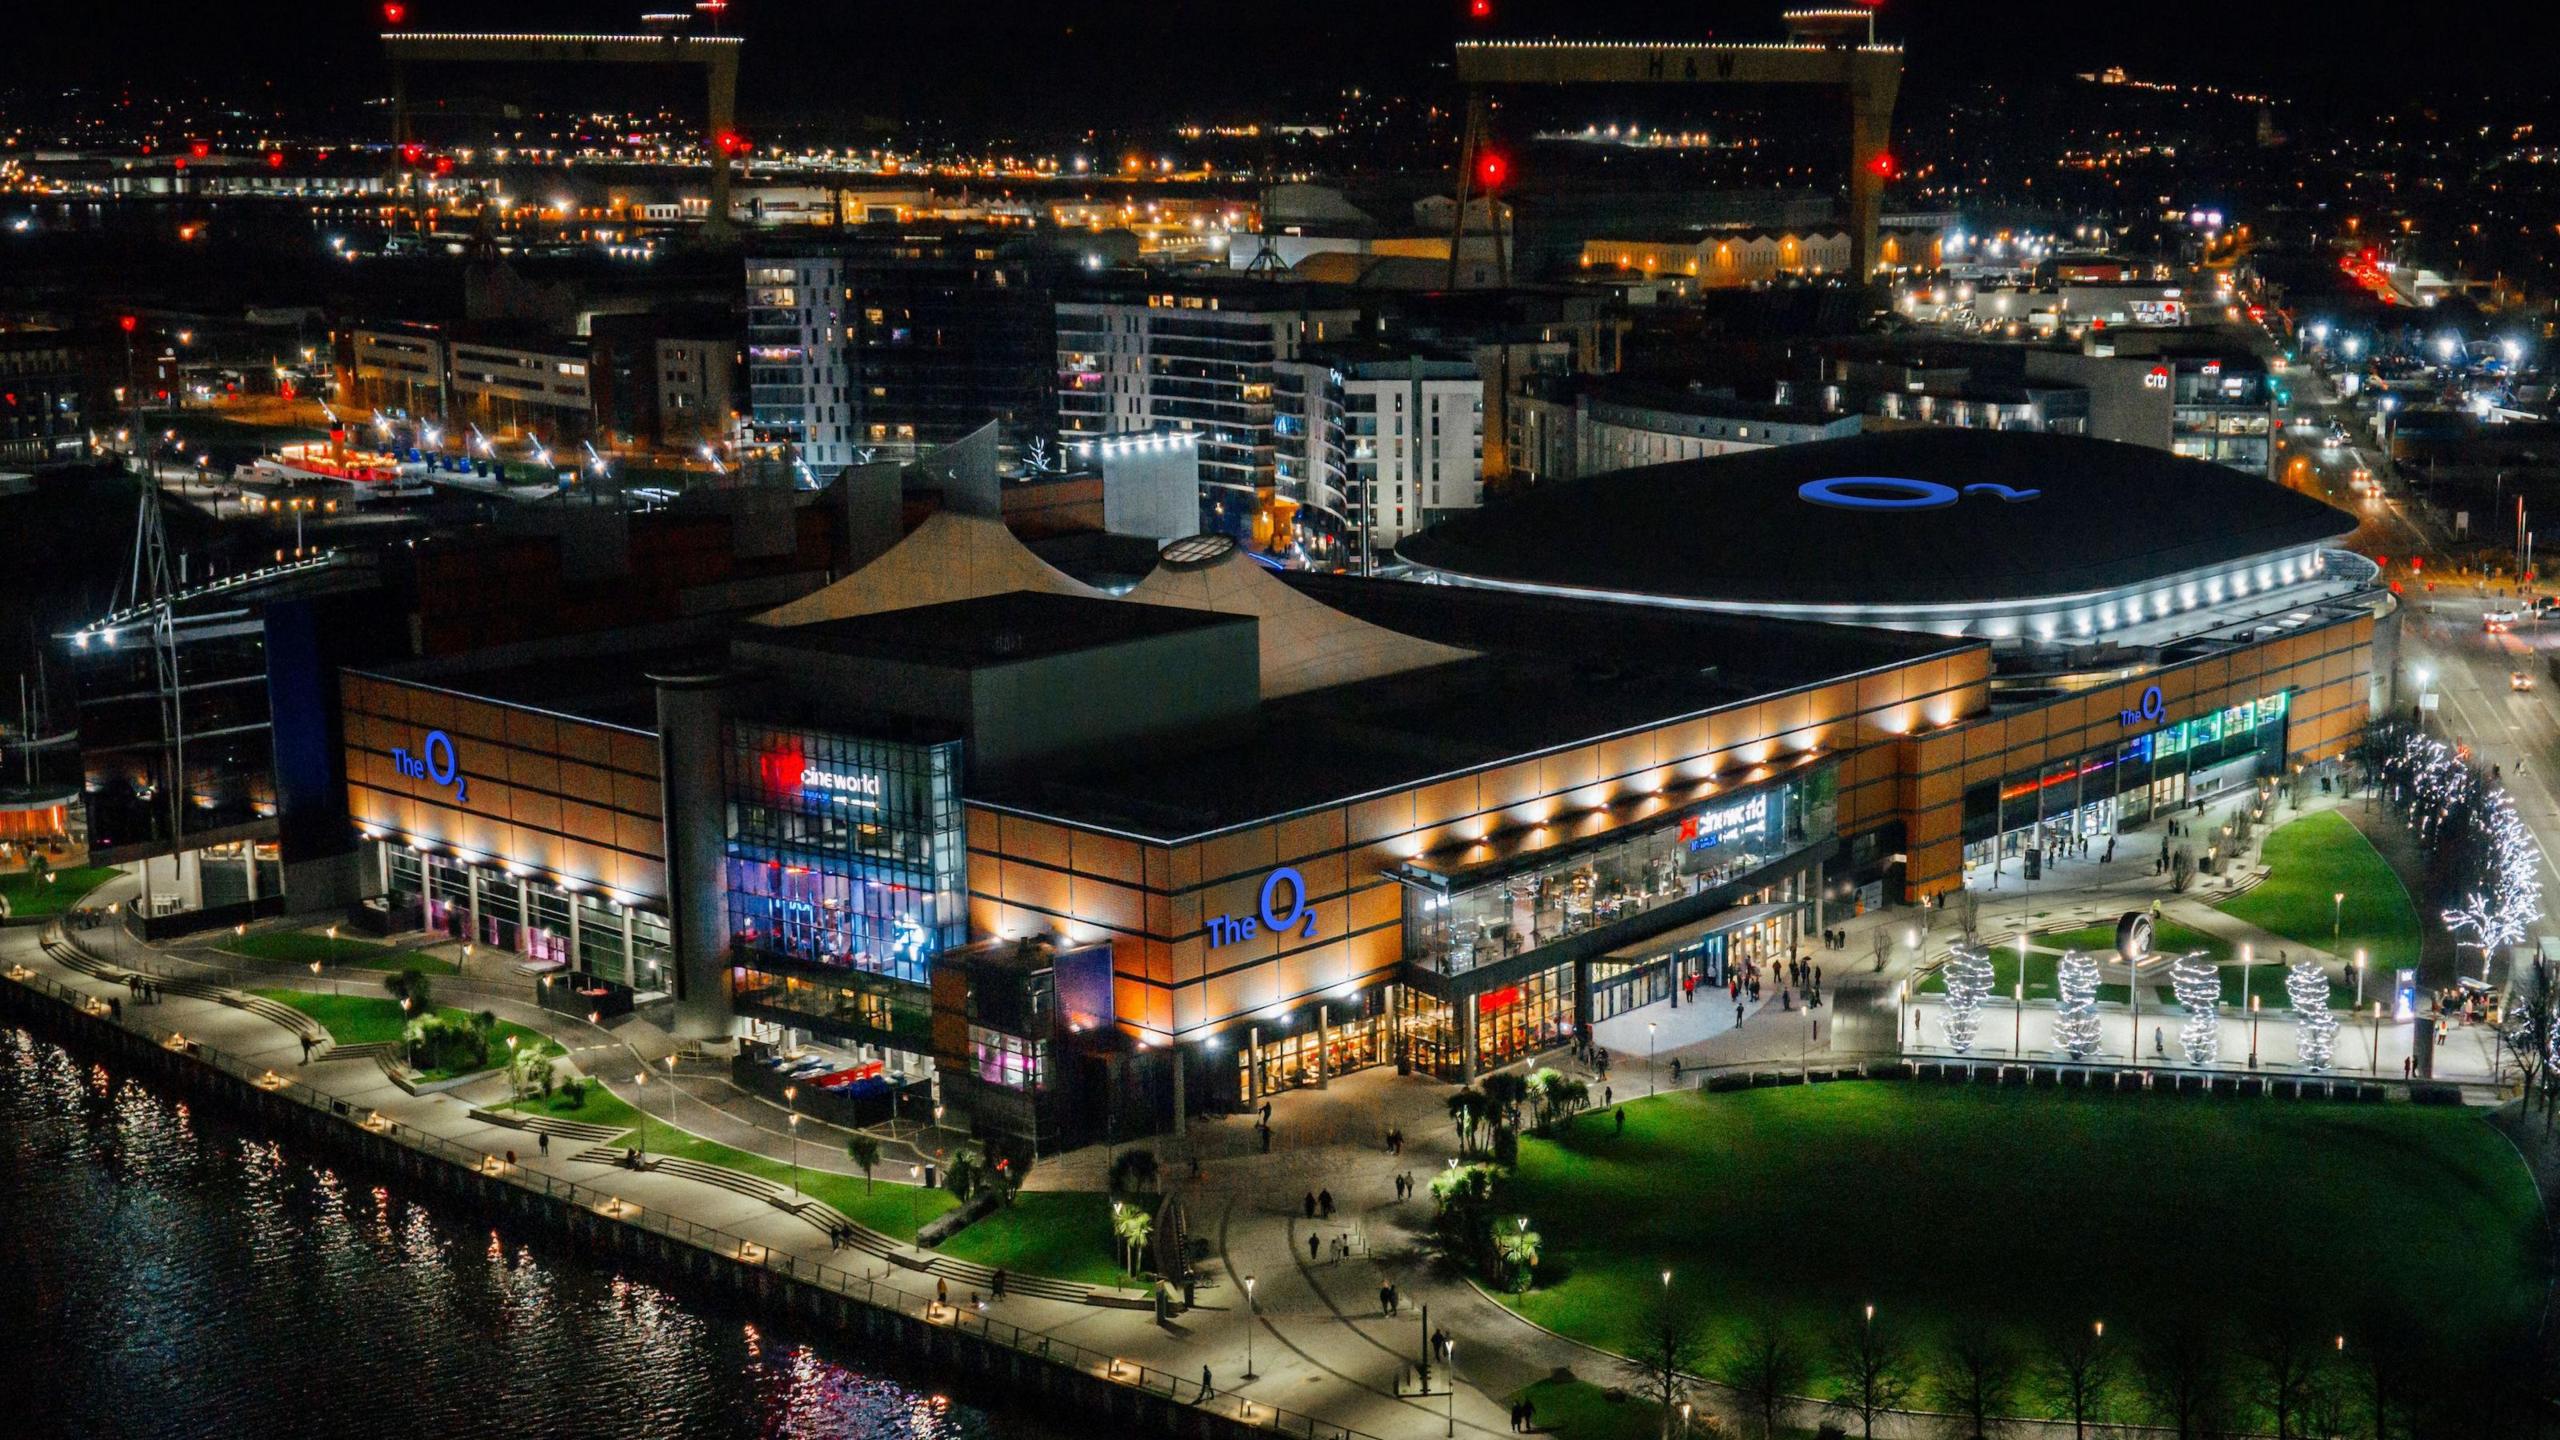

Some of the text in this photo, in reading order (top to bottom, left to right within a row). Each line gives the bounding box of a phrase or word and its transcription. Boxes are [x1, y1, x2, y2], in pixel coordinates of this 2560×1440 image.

[1648, 51, 1664, 78] H
[1715, 51, 1736, 77] W
[2144, 373, 2167, 388] citi
[2202, 366, 2219, 374] citi
[2121, 686, 2166, 727] The O2
[391, 729, 466, 802] The O2
[801, 766, 880, 795] cineworld
[1205, 867, 1319, 949] The O2
